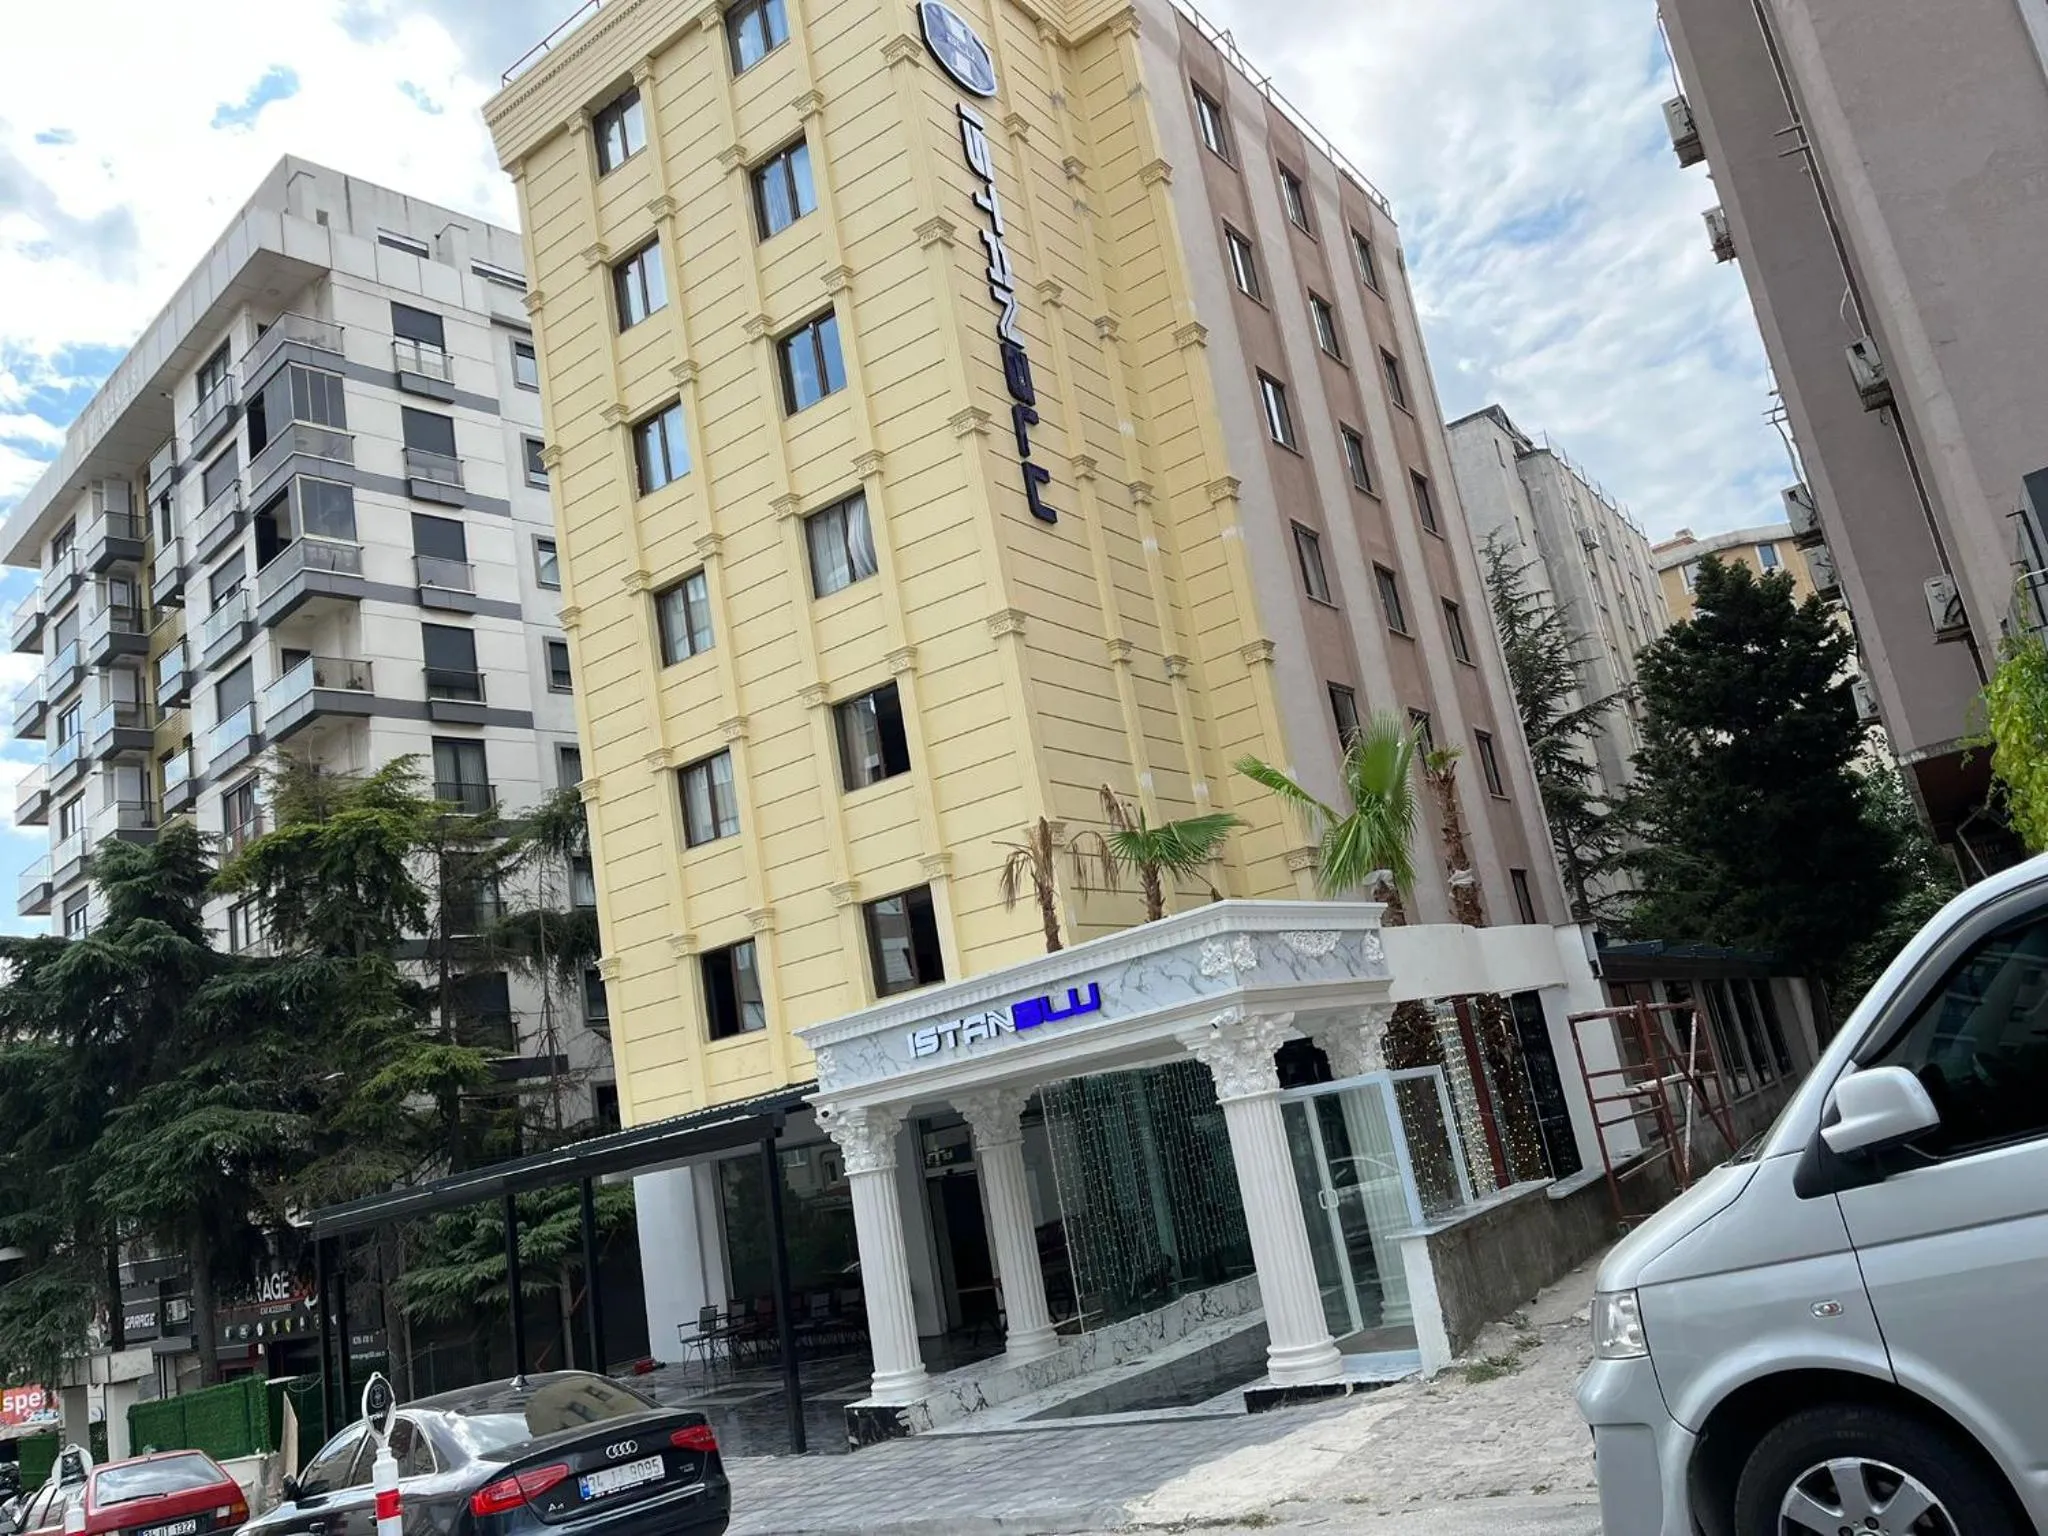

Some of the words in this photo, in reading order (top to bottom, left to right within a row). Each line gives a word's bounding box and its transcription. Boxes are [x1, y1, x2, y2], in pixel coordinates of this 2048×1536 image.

[957, 102, 1058, 523] ISTANBLU
[907, 982, 1101, 1058] ISTANBLU
[246, 1271, 290, 1302] RAGE
[124, 1312, 156, 1330] GARAGE
